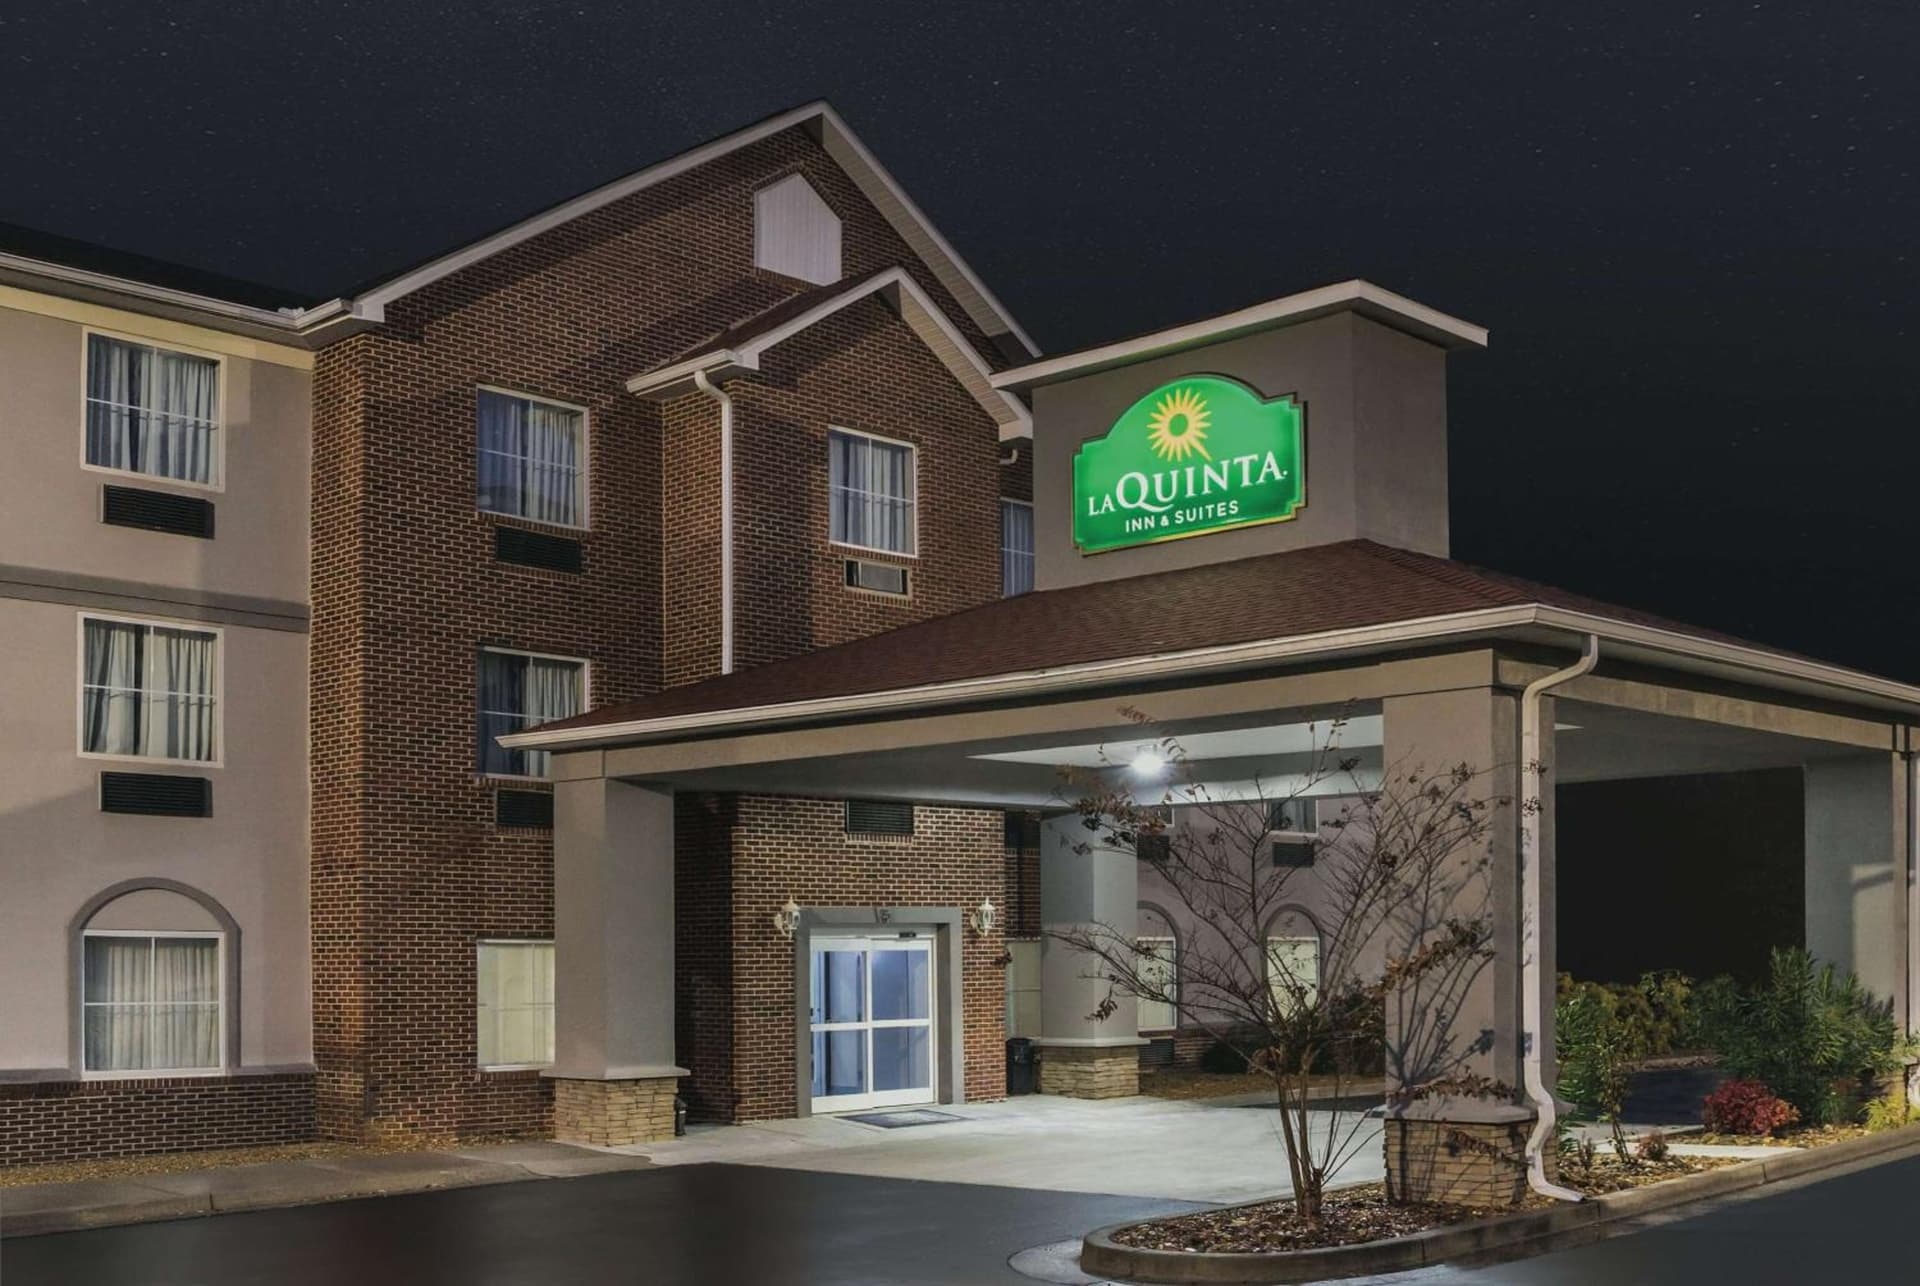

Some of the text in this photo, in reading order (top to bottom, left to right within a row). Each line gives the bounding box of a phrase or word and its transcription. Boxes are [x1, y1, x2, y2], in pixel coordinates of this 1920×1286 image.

[1088, 493, 1116, 516] LA
[1125, 500, 1239, 533] INN & SUITES
